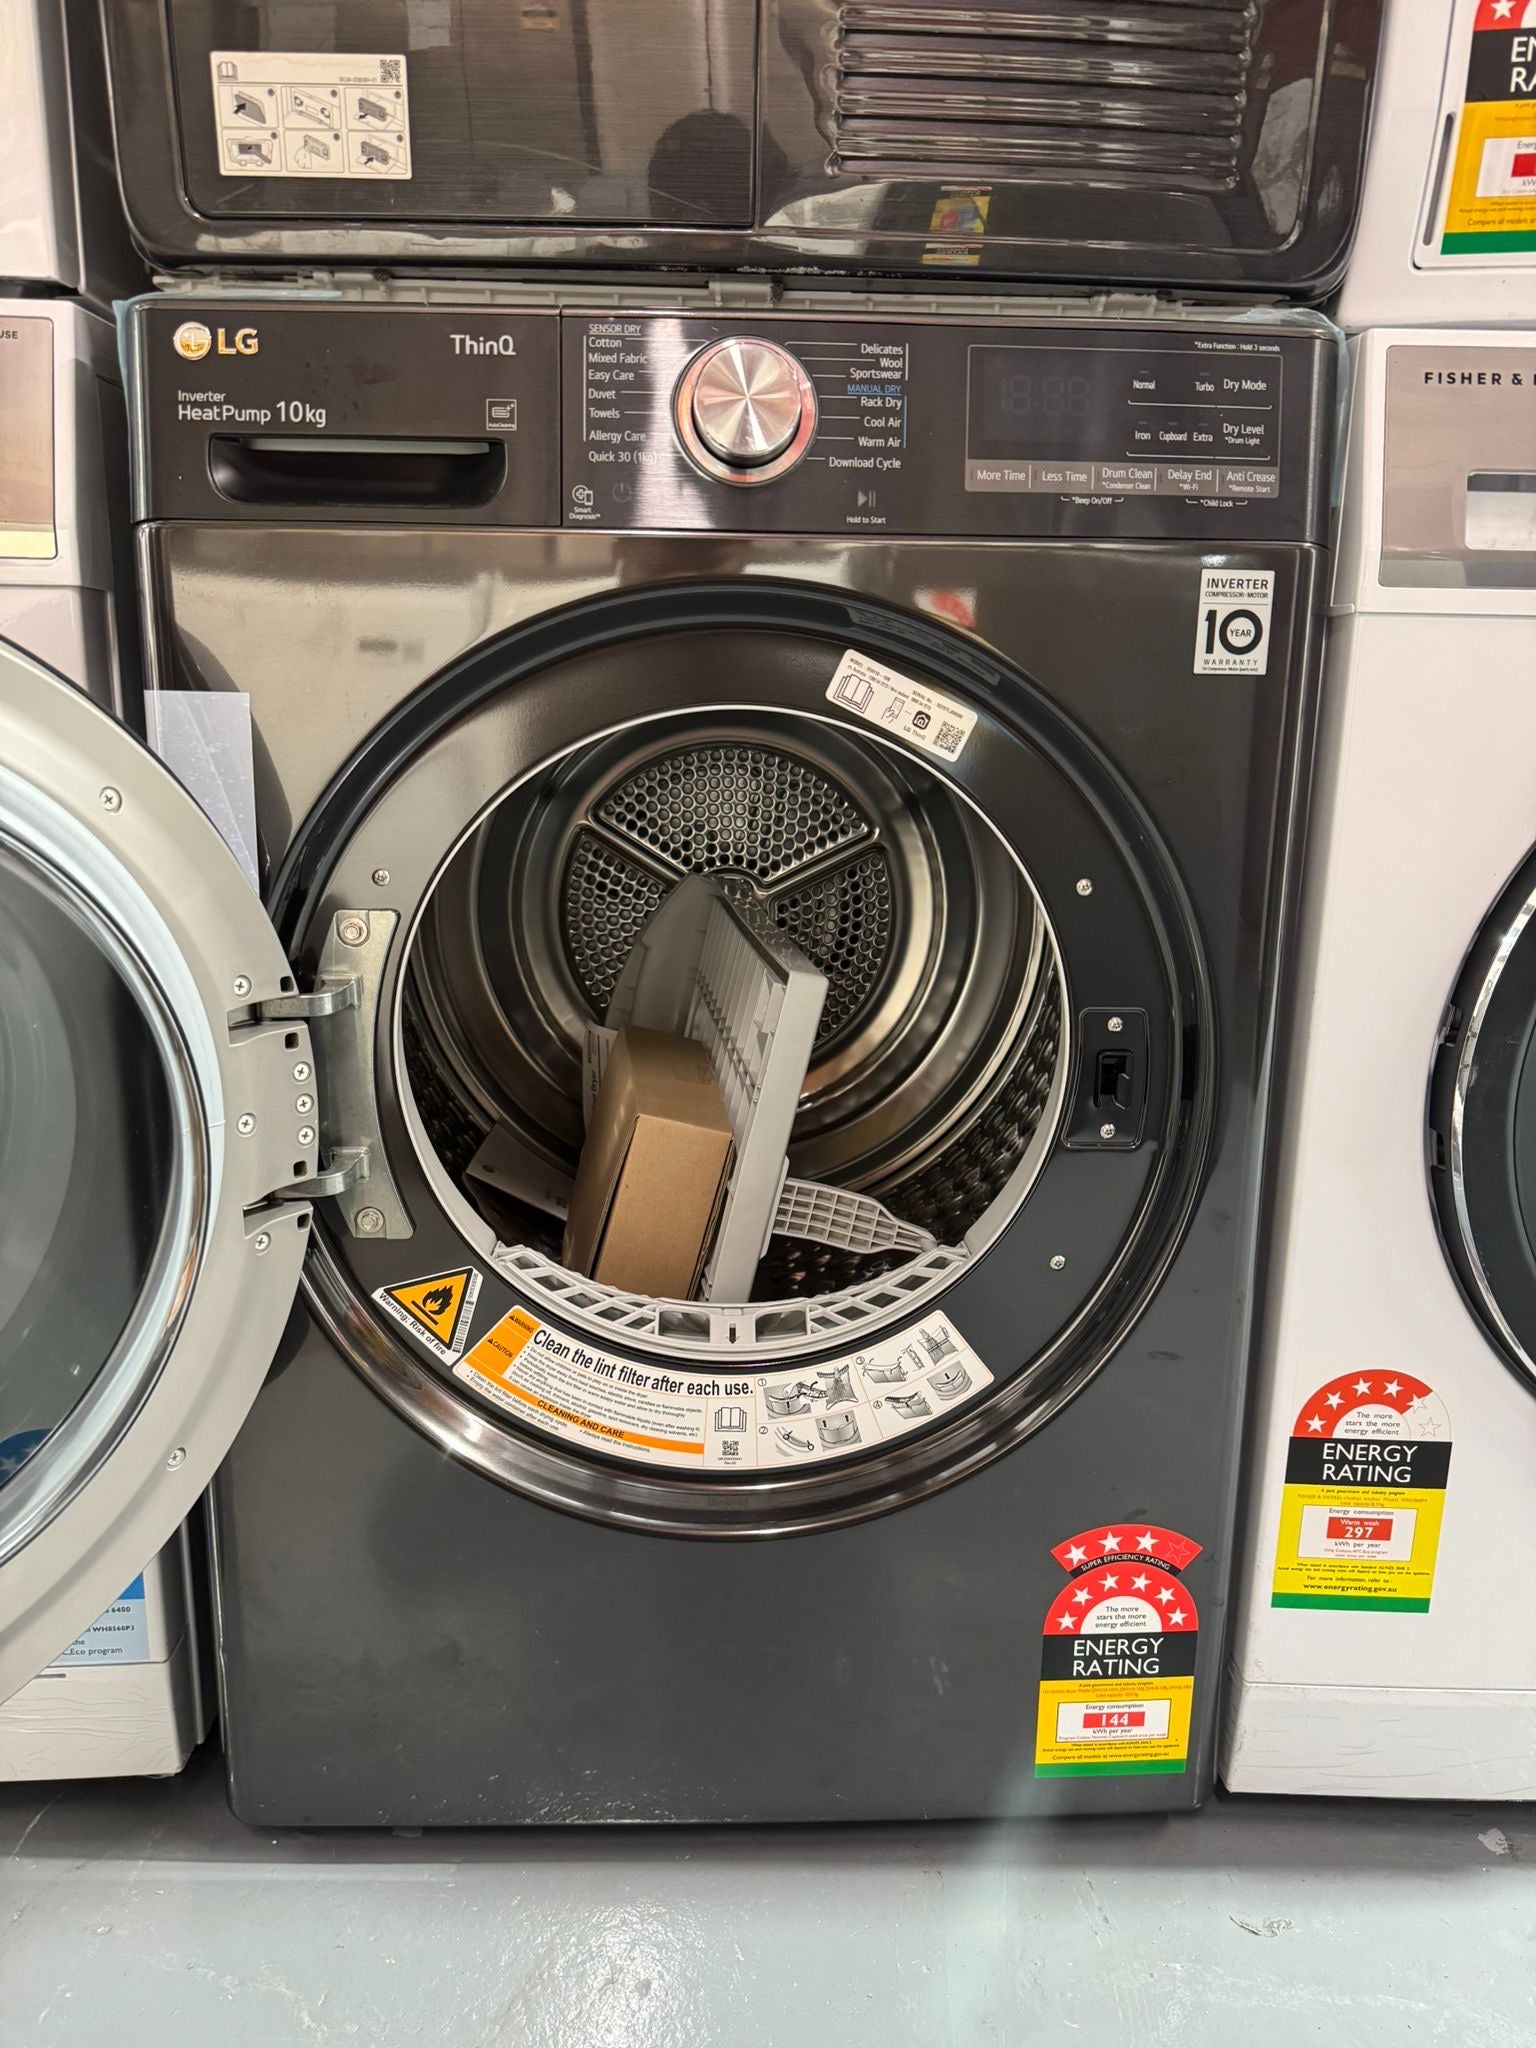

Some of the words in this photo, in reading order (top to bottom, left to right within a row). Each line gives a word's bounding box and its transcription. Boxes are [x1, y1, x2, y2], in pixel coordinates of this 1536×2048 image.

[589, 324, 622, 334] SENSOR
[623, 325, 641, 335] DRY
[217, 327, 259, 356] LG
[450, 334, 517, 356] ThinQ
[589, 337, 622, 348] Cotton
[1212, 342, 1236, 350] Function
[1240, 343, 1253, 351] Hold
[1259, 344, 1280, 352] seconds
[861, 343, 903, 355] Delicates
[589, 353, 618, 364] Mixed
[620, 354, 648, 364] Fabric
[880, 357, 903, 368] Wool
[589, 370, 611, 382] Easy
[613, 370, 635, 381] Care
[850, 367, 903, 380] Sportswear
[1424, 371, 1503, 386] FISHER
[1511, 372, 1524, 386] &
[847, 383, 880, 394] MANUAL
[882, 384, 902, 394] DRY
[1133, 379, 1156, 390] Normal
[1195, 381, 1215, 393] Turbo
[1223, 379, 1240, 392] Dry
[1241, 380, 1267, 391] Mode
[178, 390, 226, 403] Inverter
[589, 388, 616, 399] Duvet
[861, 397, 883, 408] Rack
[885, 397, 902, 410] Dry
[276, 401, 327, 428] 10kg
[589, 408, 620, 419] Towels
[864, 416, 886, 428] Cool
[887, 417, 902, 428] Air
[1223, 423, 1239, 436] Dry
[1241, 424, 1265, 435] Level
[589, 430, 621, 444] Allergy
[623, 431, 647, 442] Care
[1135, 430, 1151, 441] Iron
[1159, 431, 1187, 443] Cupboard
[1193, 432, 1213, 443] Extra
[858, 436, 886, 448] Warm
[887, 437, 902, 448] Air
[1244, 437, 1261, 446] Light
[588, 450, 615, 462] Quick
[618, 451, 631, 462] 30
[829, 456, 876, 469] Download
[878, 457, 902, 470] Cycle
[977, 470, 1002, 481] More
[1003, 470, 1026, 481] Time
[1042, 471, 1063, 482] Less
[1065, 472, 1088, 483] Time
[1102, 468, 1126, 479] Drum
[1128, 468, 1153, 480] Clean
[1168, 469, 1192, 482] Delay
[1193, 470, 1213, 481] End
[1227, 471, 1245, 482] Anti
[1247, 471, 1276, 483] Crease
[1136, 482, 1151, 491] Clean
[1255, 485, 1271, 493] Start
[1092, 497, 1113, 506] On/Off
[1220, 499, 1234, 508] Lock
[573, 506, 592, 514] Smart
[846, 515, 861, 524] Hold
[862, 516, 869, 524] to
[870, 516, 887, 524] Start
[1206, 577, 1269, 590] INVERTER
[1205, 590, 1245, 598] COMPRESSOR
[1247, 591, 1269, 599] MOTOR
[1204, 608, 1264, 656] 10
[1230, 629, 1252, 637] YEAR
[1203, 658, 1259, 667] WARRANTY
[378, 1291, 409, 1323] Warning:
[409, 1320, 427, 1337] Risk
[425, 1333, 435, 1345] of
[433, 1342, 446, 1356] fire
[513, 1317, 535, 1334] WARNING
[492, 1340, 514, 1358] CAUTION
[533, 1329, 569, 1358] Clean
[568, 1345, 592, 1367] the
[592, 1353, 617, 1378] lint
[616, 1364, 650, 1388] filter
[650, 1374, 685, 1395] after
[686, 1379, 721, 1396] each
[724, 1382, 754, 1396] use.
[536, 1399, 581, 1426] CLEANING
[579, 1417, 601, 1431] AND
[599, 1425, 625, 1439] CARE
[1357, 1411, 1371, 1419] The
[1345, 1419, 1363, 1427] stars
[1344, 1428, 1369, 1437] energy
[1371, 1428, 1400, 1436] efficient
[1322, 1442, 1419, 1463] ENERGY
[1321, 1463, 1412, 1484] RATING
[1328, 1507, 1351, 1516] Energy
[1353, 1509, 1395, 1517] consumption
[1339, 1518, 1360, 1527] Warm
[1363, 1519, 1380, 1527] wash
[1344, 1526, 1375, 1539] 297
[1334, 1540, 1351, 1548] kWh
[1353, 1541, 1364, 1549] per
[1367, 1542, 1381, 1550] year
[1080, 1557, 1103, 1572] SUPER
[1103, 1553, 1145, 1564] EFFICIENCY
[1144, 1556, 1171, 1571] RATING
[1306, 1574, 1316, 1582] For
[1303, 1583, 1398, 1593] www.energyrating.gov.au
[111, 1605, 131, 1613] 6400
[1105, 1605, 1119, 1613] The
[1096, 1612, 1113, 1621] stars
[1114, 1612, 1126, 1620] the
[1095, 1620, 1119, 1630] energy
[1120, 1620, 1147, 1629] efficient
[88, 1647, 124, 1656] program
[1073, 1637, 1165, 1658] ENERGY
[1071, 1657, 1160, 1677] RATING
[1085, 1703, 1106, 1711] Energy
[1106, 1702, 1145, 1710] consumption
[1101, 1713, 1130, 1727] 144
[1108, 1728, 1119, 1736] per
[1108, 1751, 1170, 1760] www.energyrating.gov.au
